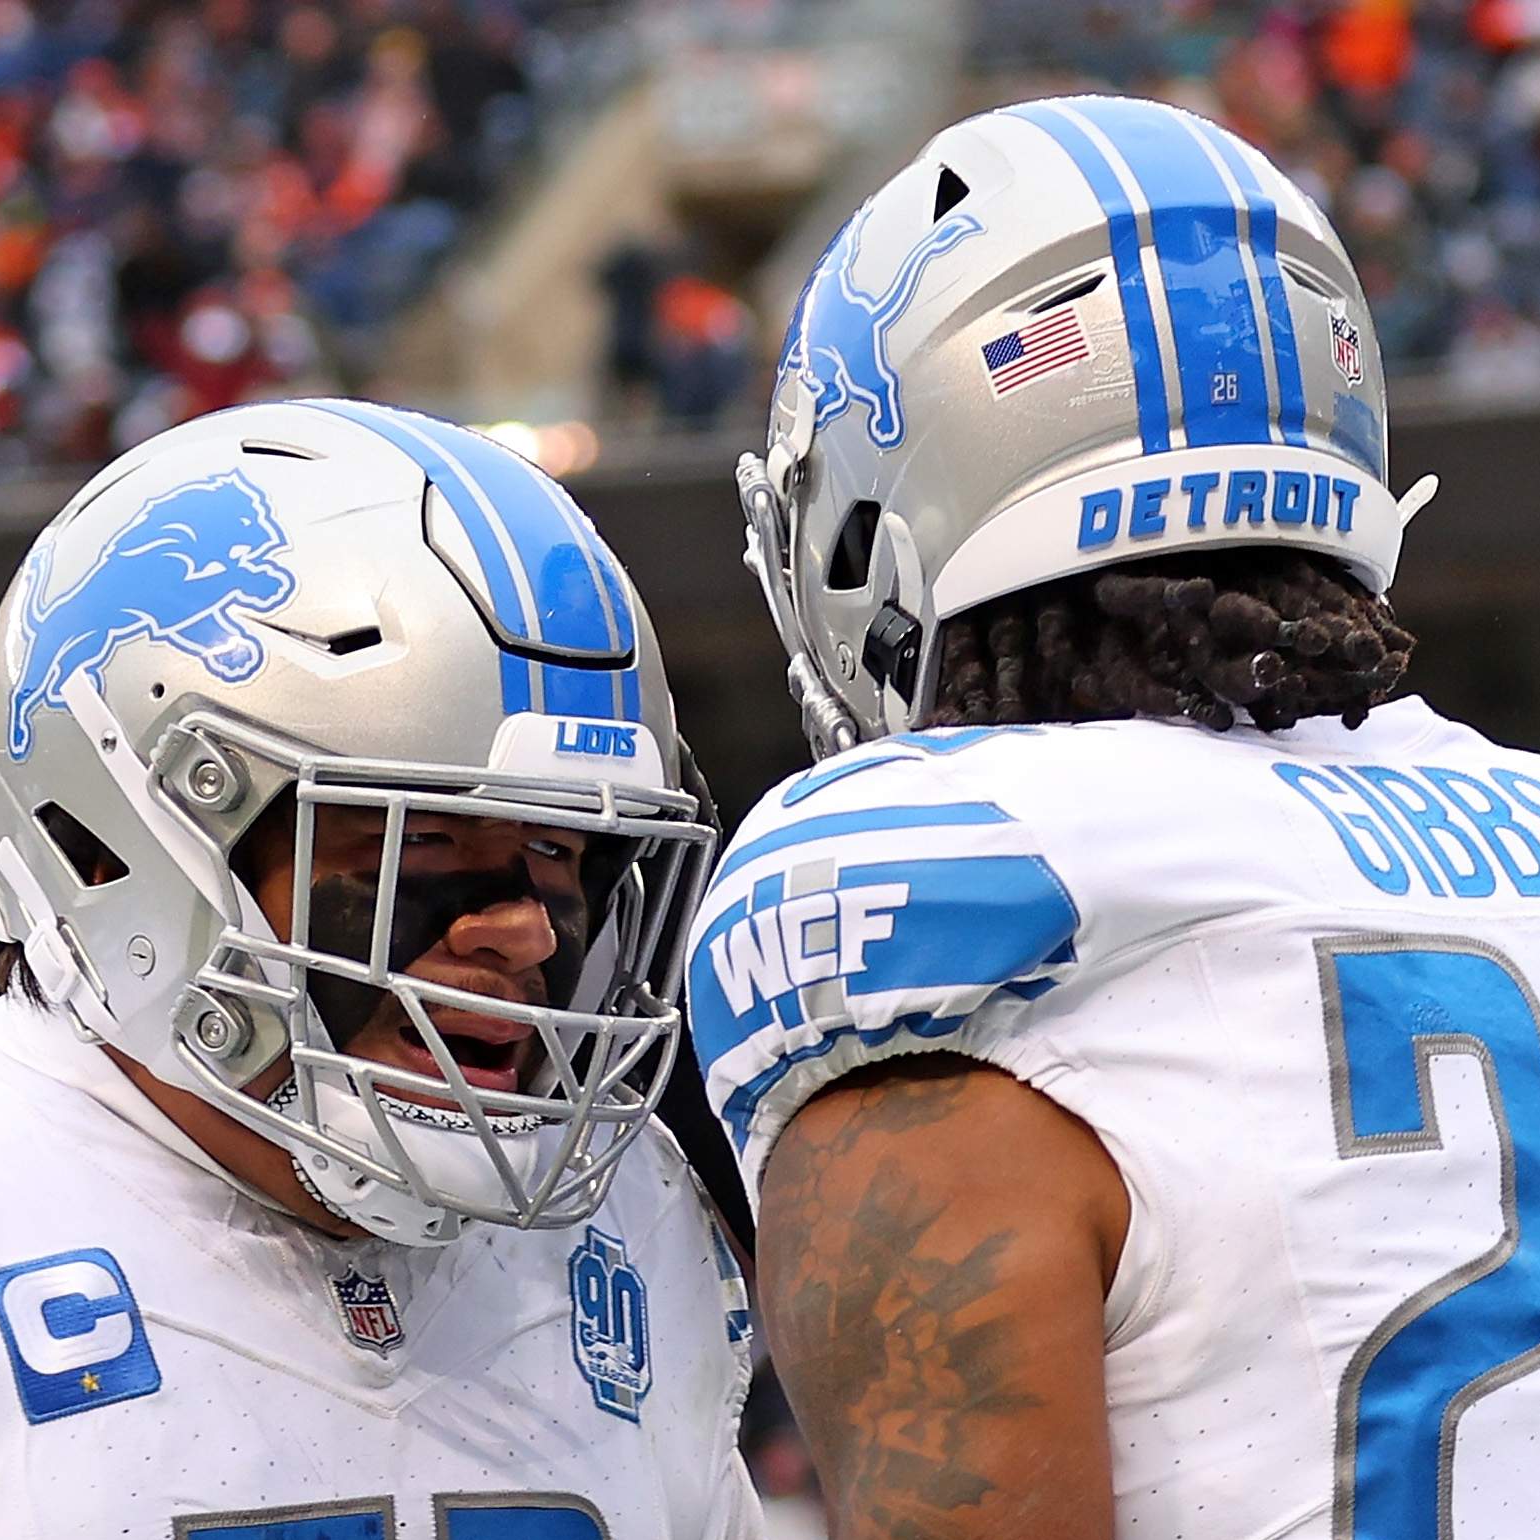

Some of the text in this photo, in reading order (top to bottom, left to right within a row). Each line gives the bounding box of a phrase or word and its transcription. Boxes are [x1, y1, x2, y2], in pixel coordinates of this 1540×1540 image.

[1214, 373, 1238, 402] 26
[1077, 470, 1361, 550] DETROIT
[555, 721, 637, 758] LIONS
[709, 882, 909, 1018] WCF
[3, 1261, 133, 1375] C
[578, 1253, 646, 1373] 90
